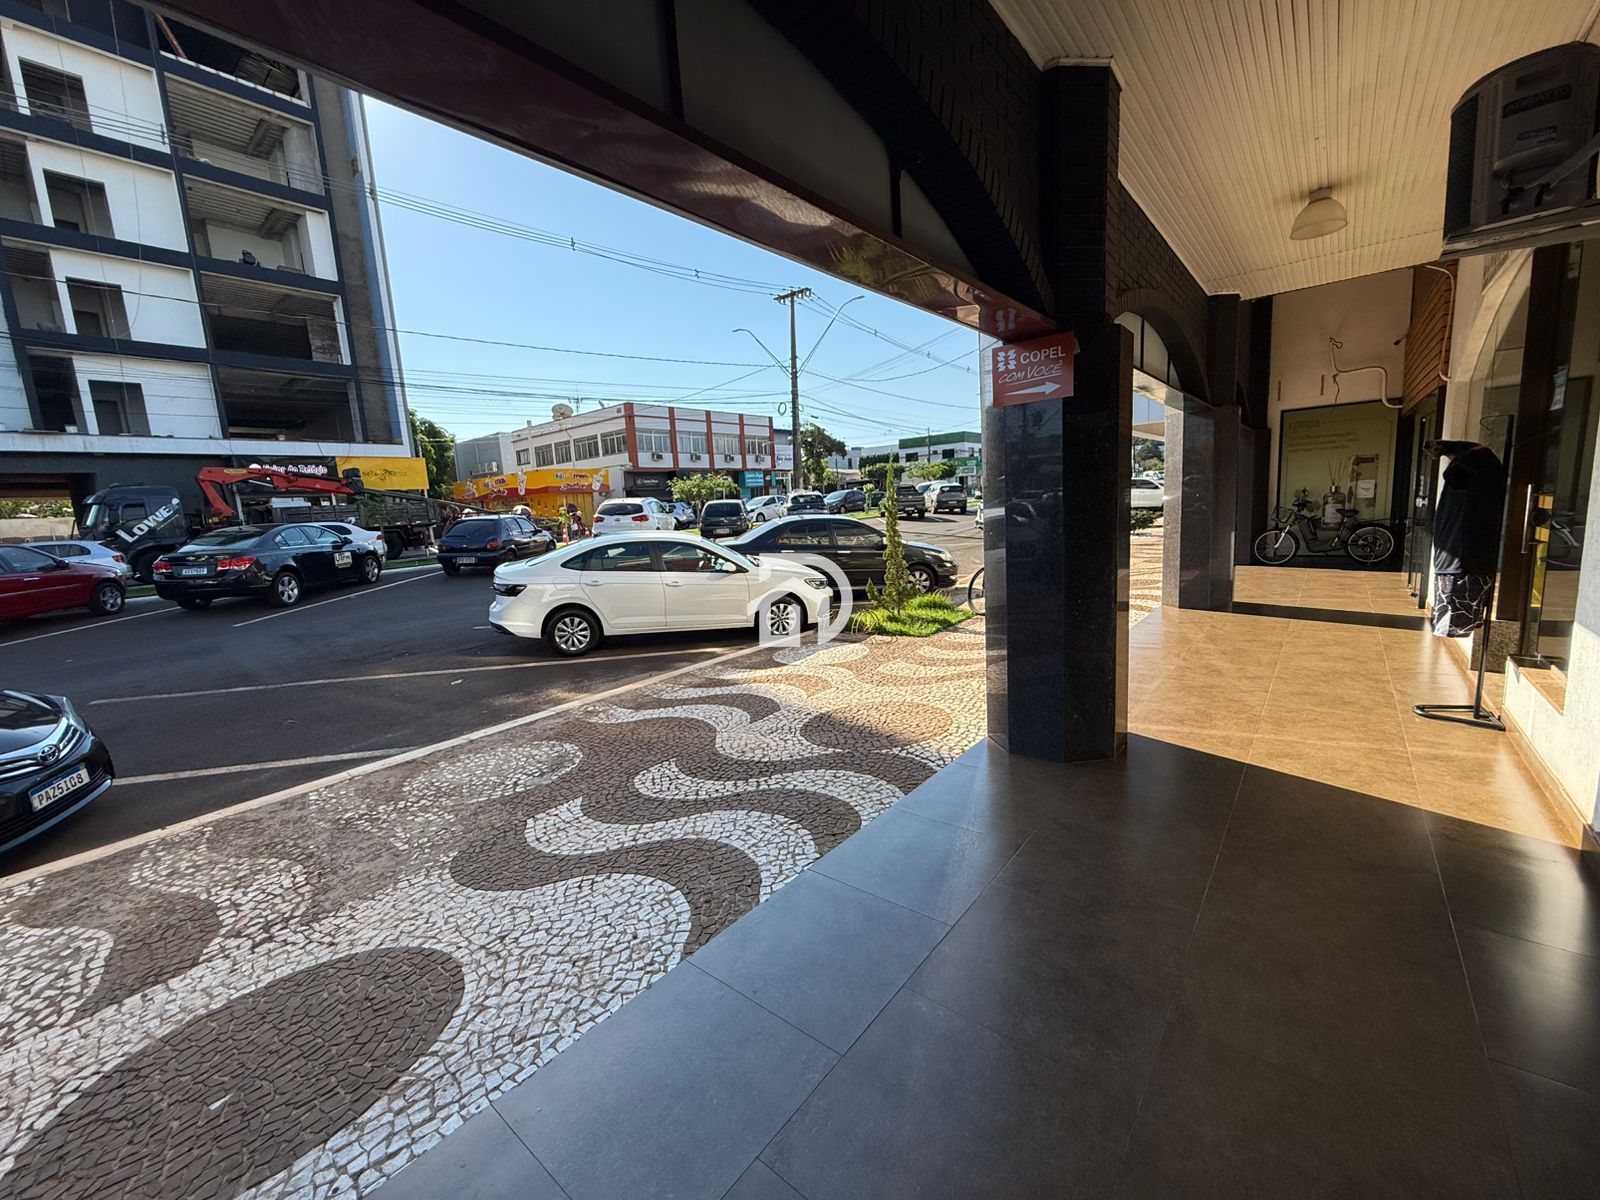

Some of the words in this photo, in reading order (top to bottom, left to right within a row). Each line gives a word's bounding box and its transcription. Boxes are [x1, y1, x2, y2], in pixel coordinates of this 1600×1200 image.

[1020, 345, 1066, 364] COPEL
[998, 370, 1025, 384] COM
[115, 505, 174, 543] LOWE
